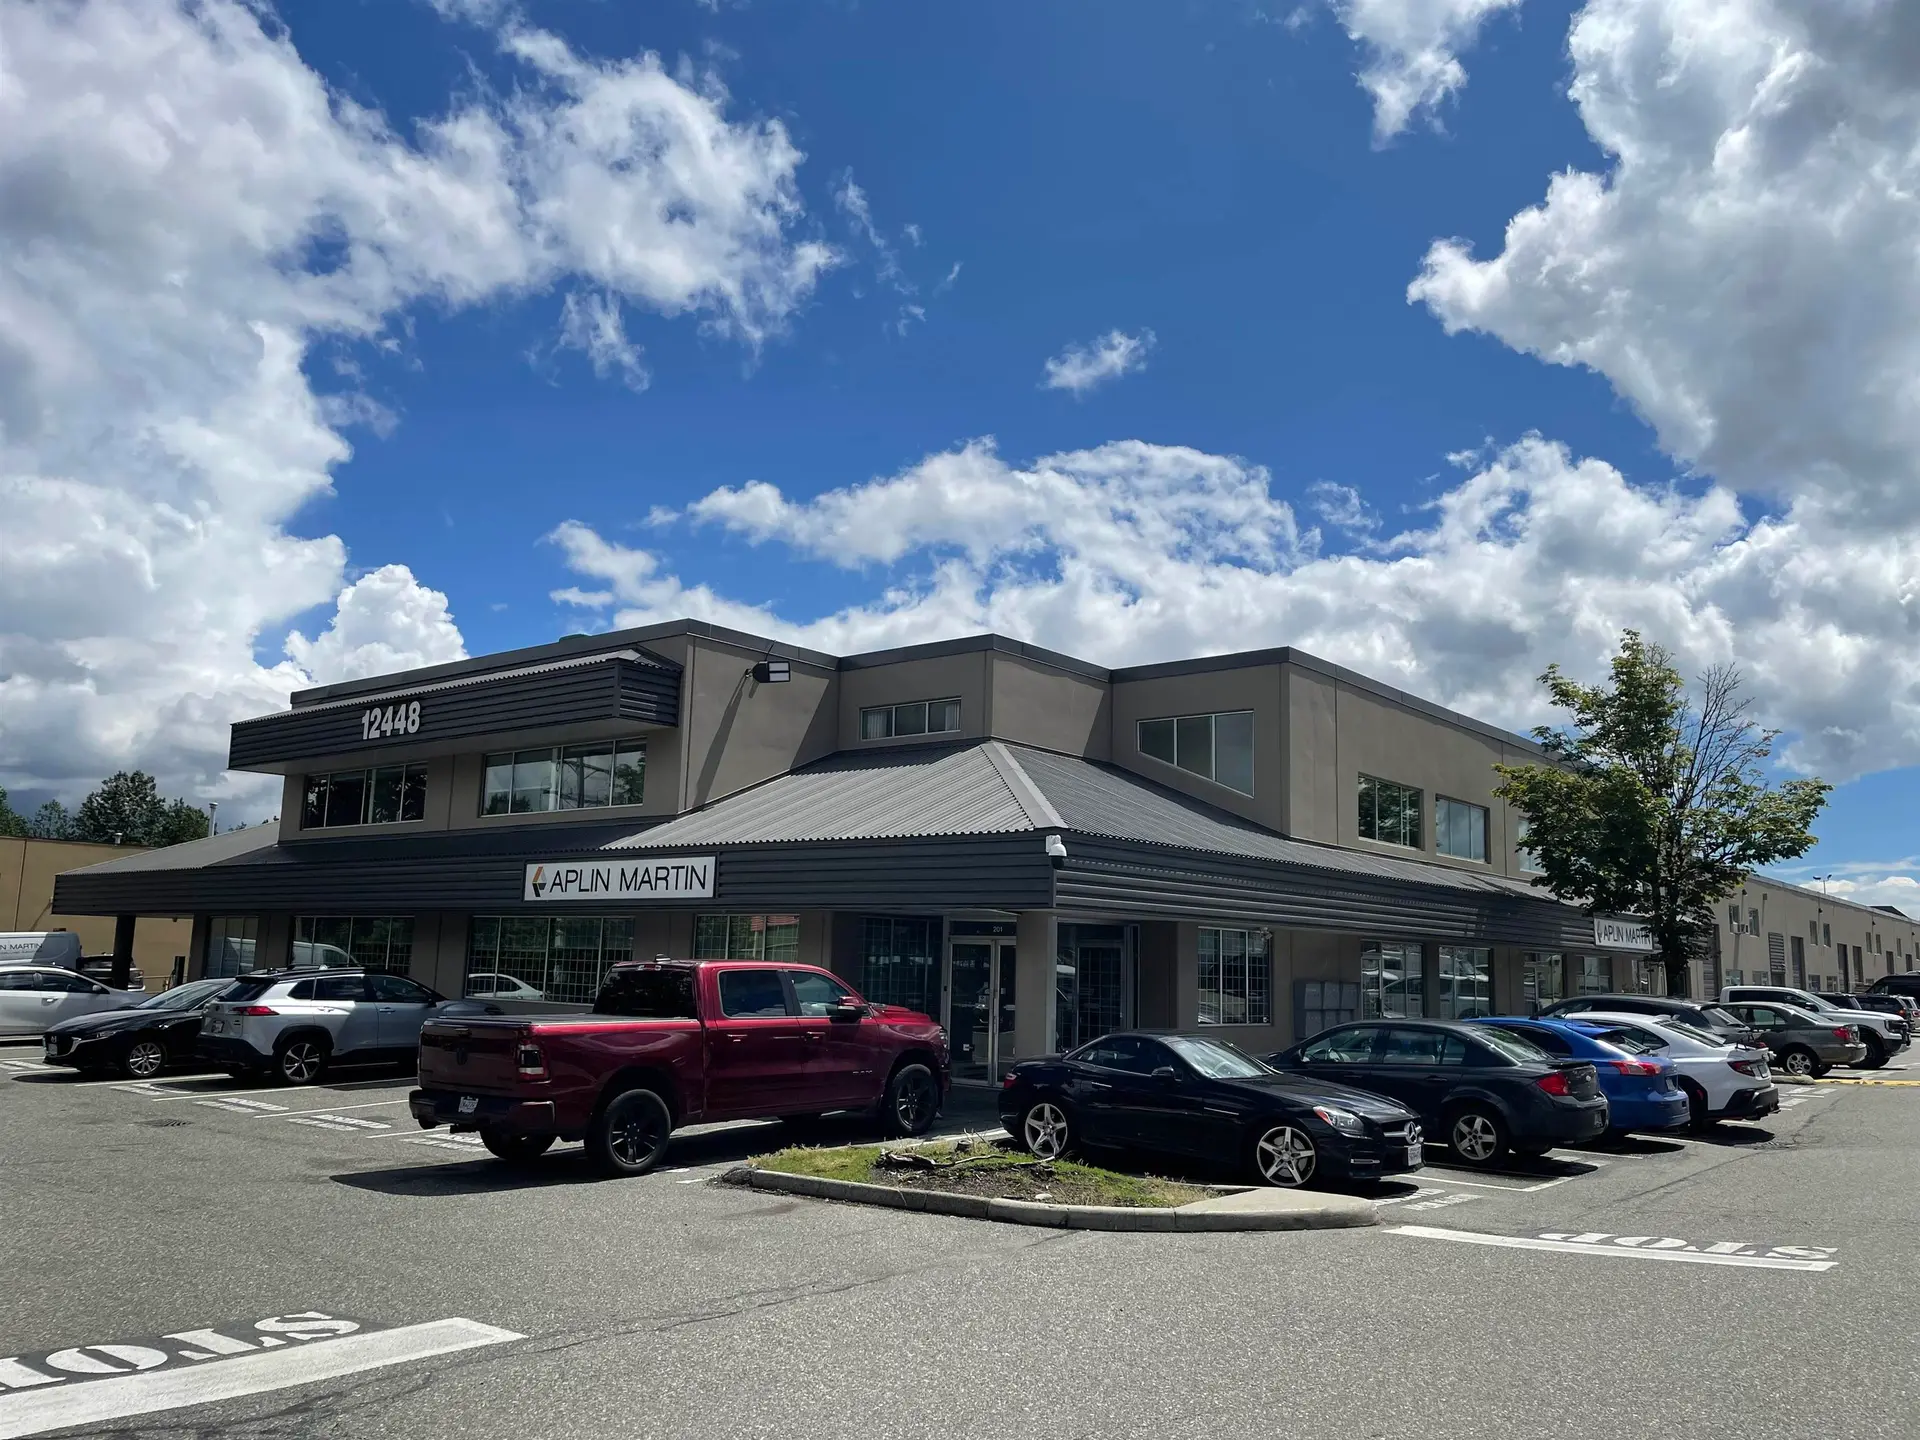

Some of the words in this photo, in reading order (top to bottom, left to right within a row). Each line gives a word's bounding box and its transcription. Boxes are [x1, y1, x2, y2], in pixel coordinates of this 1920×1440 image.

[361, 700, 421, 740] 12448
[549, 867, 611, 893] APLIN
[619, 864, 707, 892] MARTIN
[1603, 924, 1624, 942] APLIN
[1538, 1231, 1839, 1260] STOP
